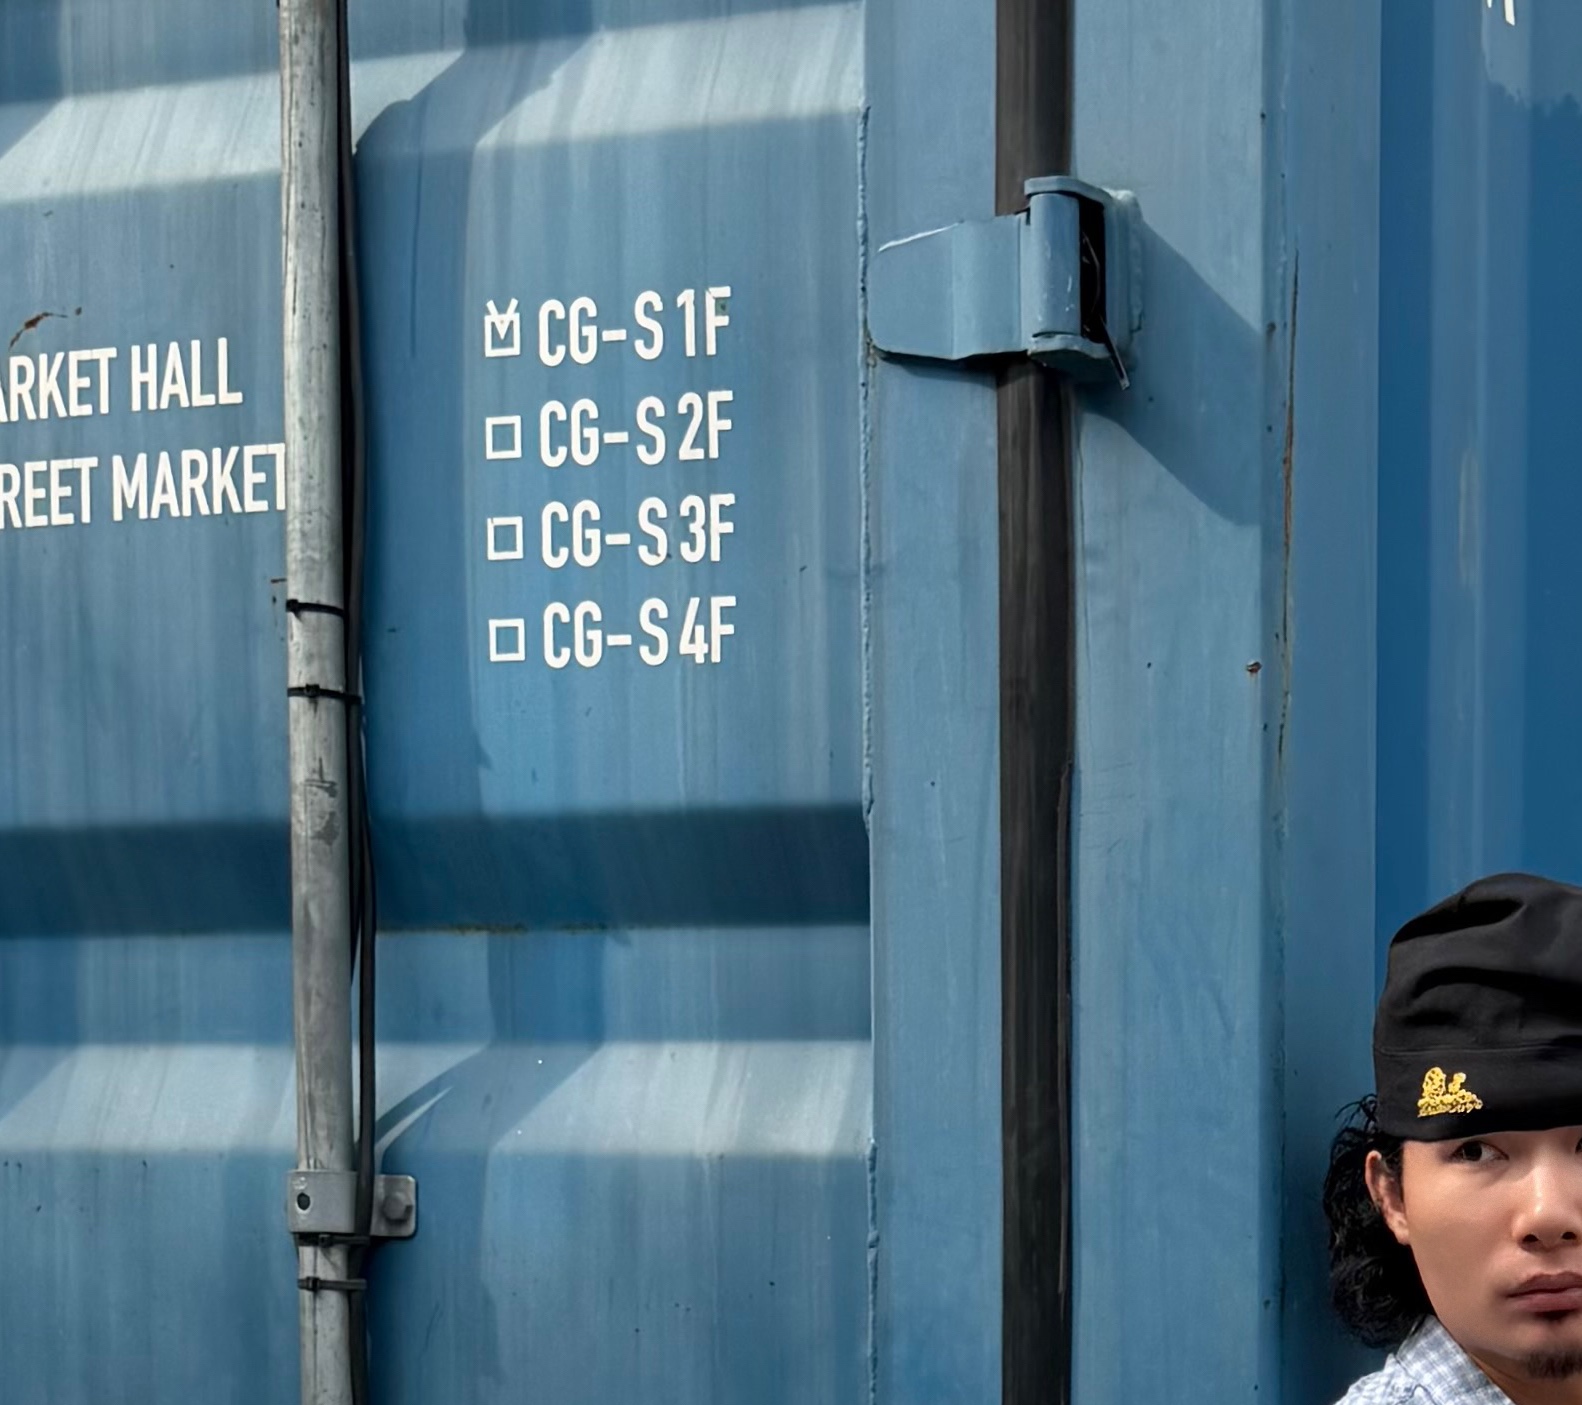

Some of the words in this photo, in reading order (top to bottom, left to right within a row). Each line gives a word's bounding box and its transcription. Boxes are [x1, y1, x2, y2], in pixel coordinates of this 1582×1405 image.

[0, 346, 118, 423] RKET
[131, 337, 243, 412] HALL
[112, 442, 286, 522] MARKET
